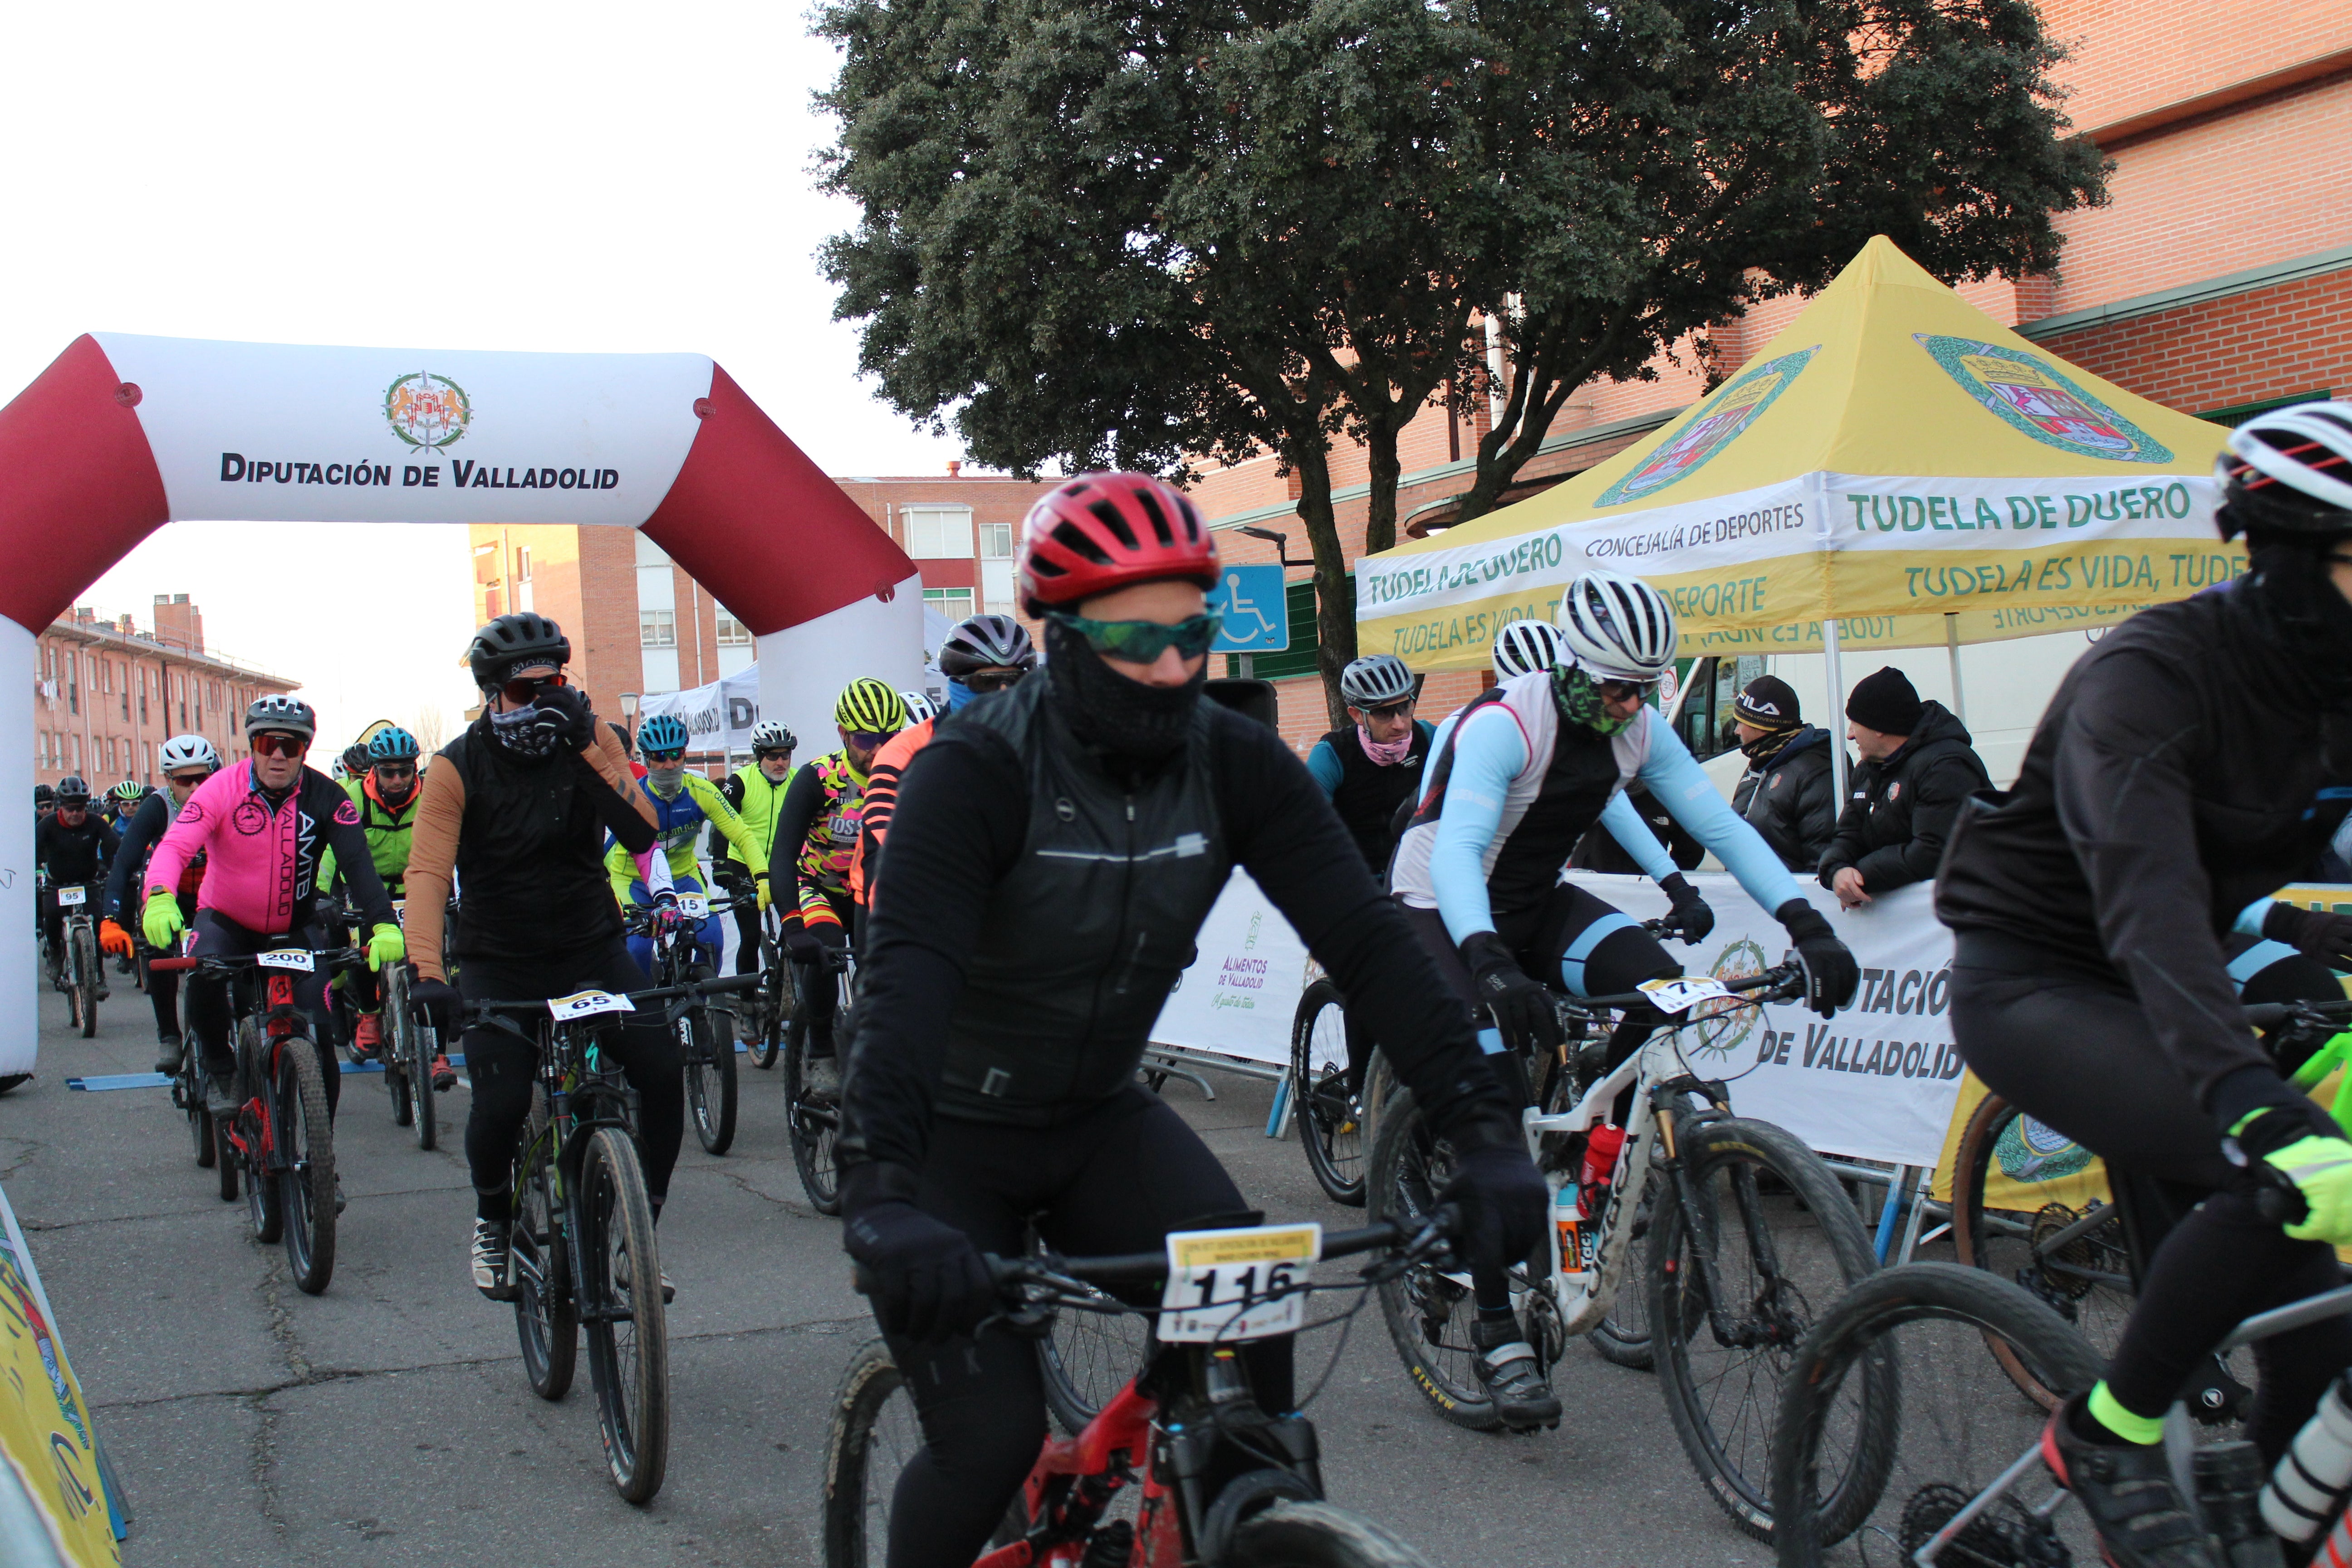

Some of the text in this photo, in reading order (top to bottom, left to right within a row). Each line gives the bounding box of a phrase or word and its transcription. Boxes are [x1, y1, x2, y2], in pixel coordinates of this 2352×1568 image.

[220, 453, 619, 490] DIPUTACIÓN DE VALLADOLID
[1847, 482, 2191, 532] TUDELA DE DUERO
[1585, 503, 1804, 558] CONCEJALÍA DE DEPORTES
[1369, 564, 1448, 605] TUDELA
[1658, 576, 1767, 618] DEPORTE
[1905, 554, 2248, 598] TUDELA ES VIDA, TUDE
[1393, 618, 1464, 656] TUDELA
[1465, 613, 1489, 644] ES
[1737, 692, 1781, 716] FILA
[296, 810, 316, 901] AMTB
[65, 892, 79, 901] 95
[265, 954, 307, 963] 200
[1222, 954, 1268, 975] ALIMENTOS
[1218, 972, 1264, 989] DE VALLADOLID
[571, 995, 611, 1009] 65
[1757, 1023, 1965, 1081] DE VALLADOLID
[1193, 1262, 1298, 1311] 116
[1412, 1365, 1456, 1411] MAXXIS
